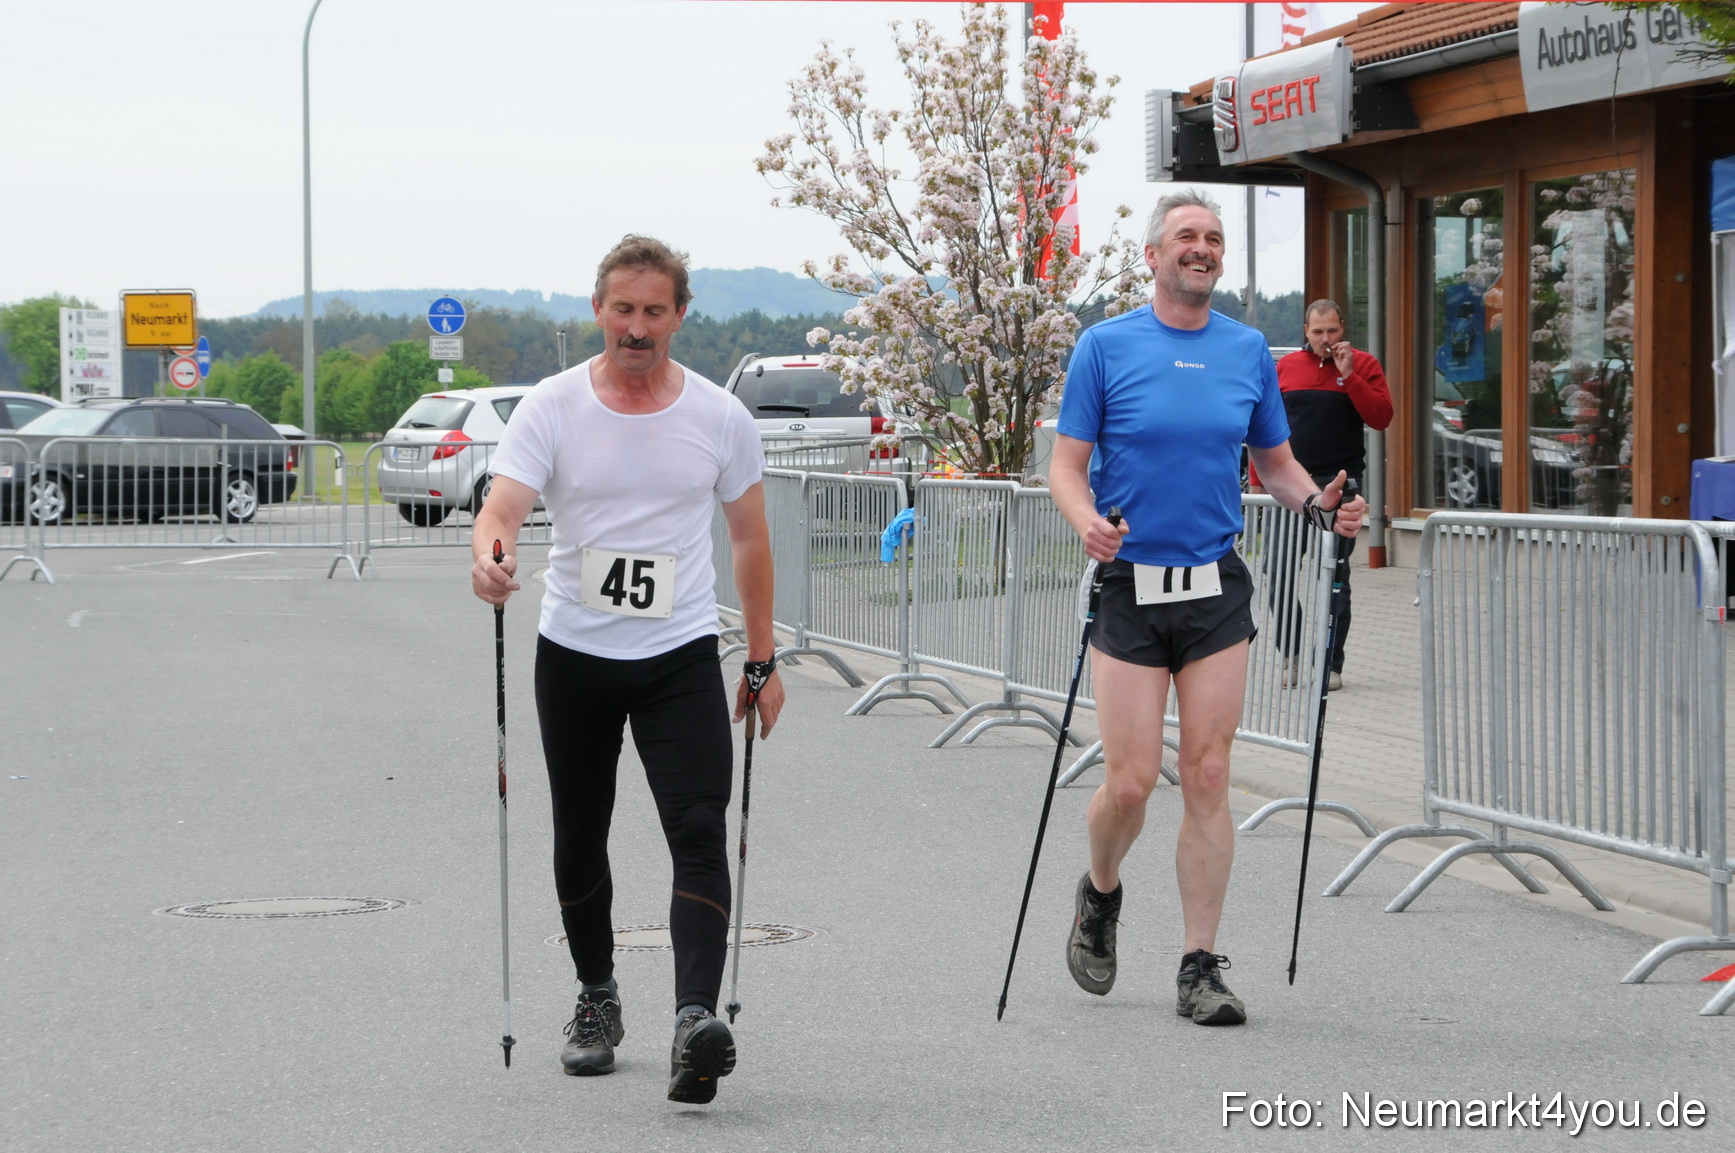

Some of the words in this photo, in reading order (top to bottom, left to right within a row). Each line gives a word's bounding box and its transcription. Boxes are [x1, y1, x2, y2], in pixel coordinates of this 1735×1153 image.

[1537, 14, 1637, 70] Autohaus
[1250, 74, 1321, 126] SEAT
[131, 312, 188, 325] Neumarkt
[600, 557, 655, 611] 45
[751, 664, 761, 690] LEKI
